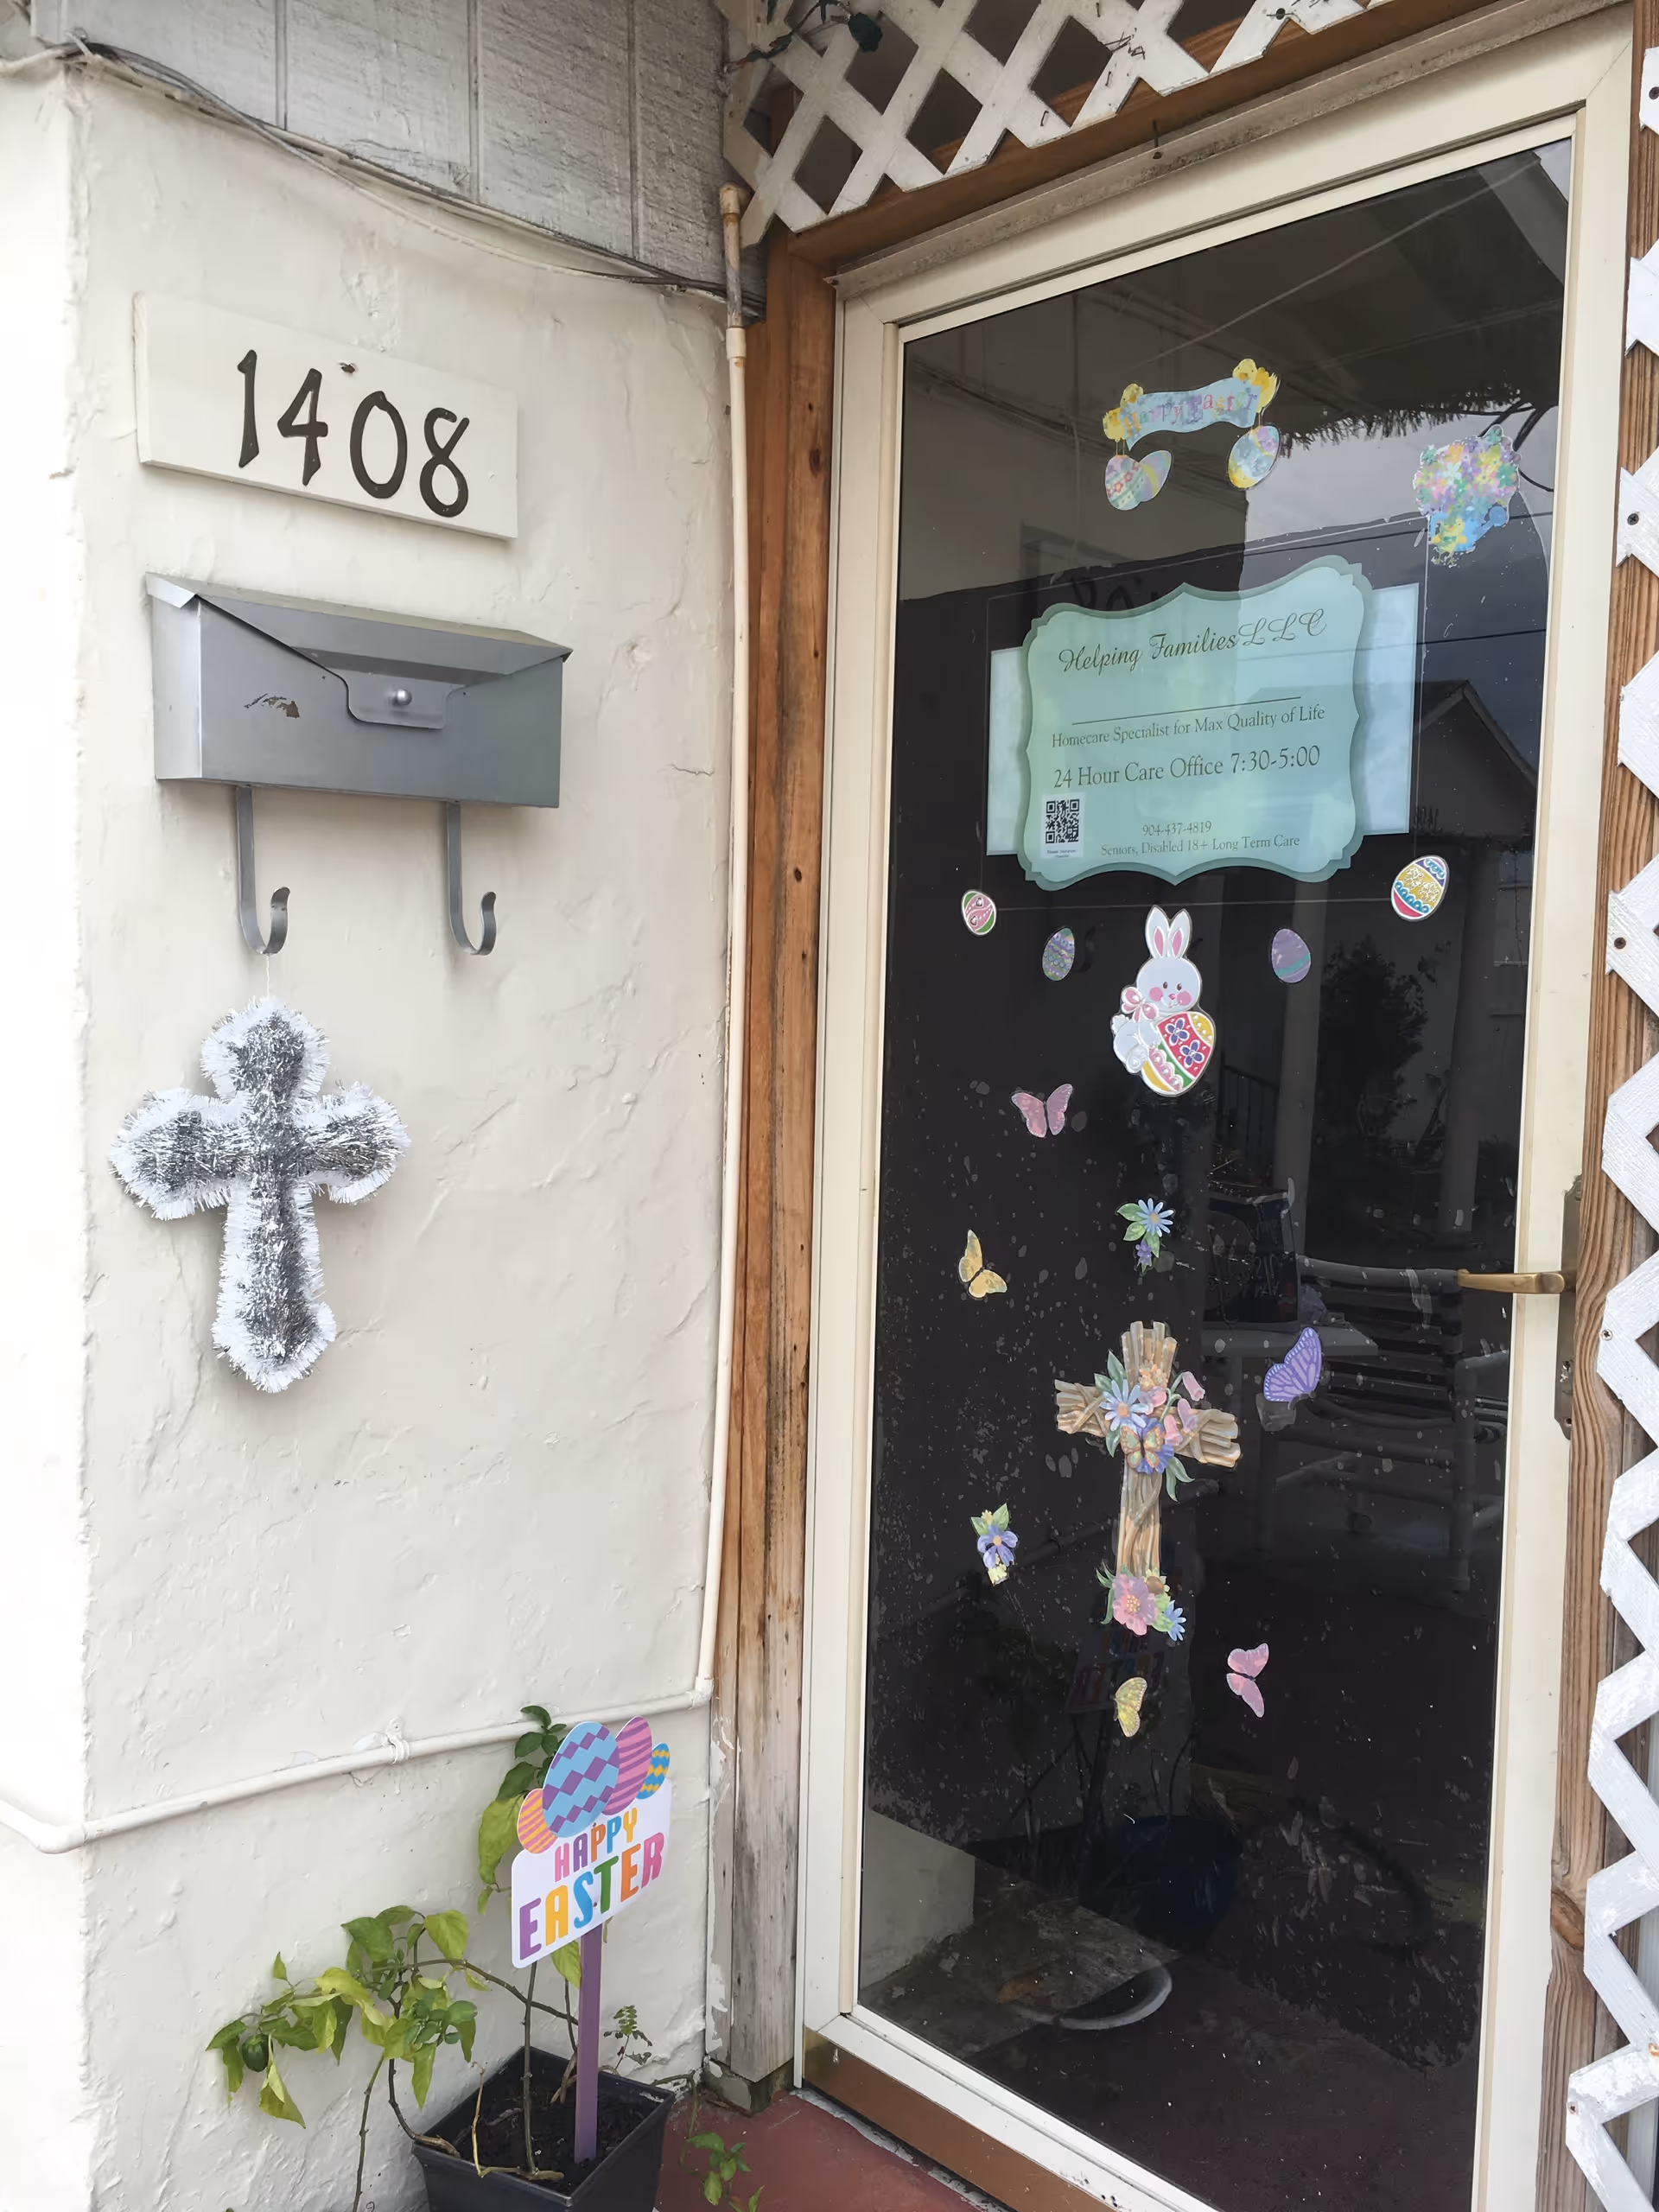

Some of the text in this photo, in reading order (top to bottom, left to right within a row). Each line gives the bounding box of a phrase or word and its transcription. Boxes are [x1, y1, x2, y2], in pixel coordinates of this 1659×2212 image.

[236, 348, 470, 518] 1408
[1123, 391, 1258, 438] Happy Easter
[1058, 644, 1142, 676] Helping
[1149, 626, 1238, 659] Families
[1052, 703, 1325, 748] Homecare Specialist for Max Quality of Life
[1053, 745, 1320, 788] 24 Hour Care Office 7:30-5:00
[1101, 834, 1300, 856] Seniors, Disabled 18+ Long Term Care
[1142, 820, 1212, 836] 904-437-4819
[554, 1808, 638, 1883] HAPPY
[519, 1832, 664, 1961] EASTER
